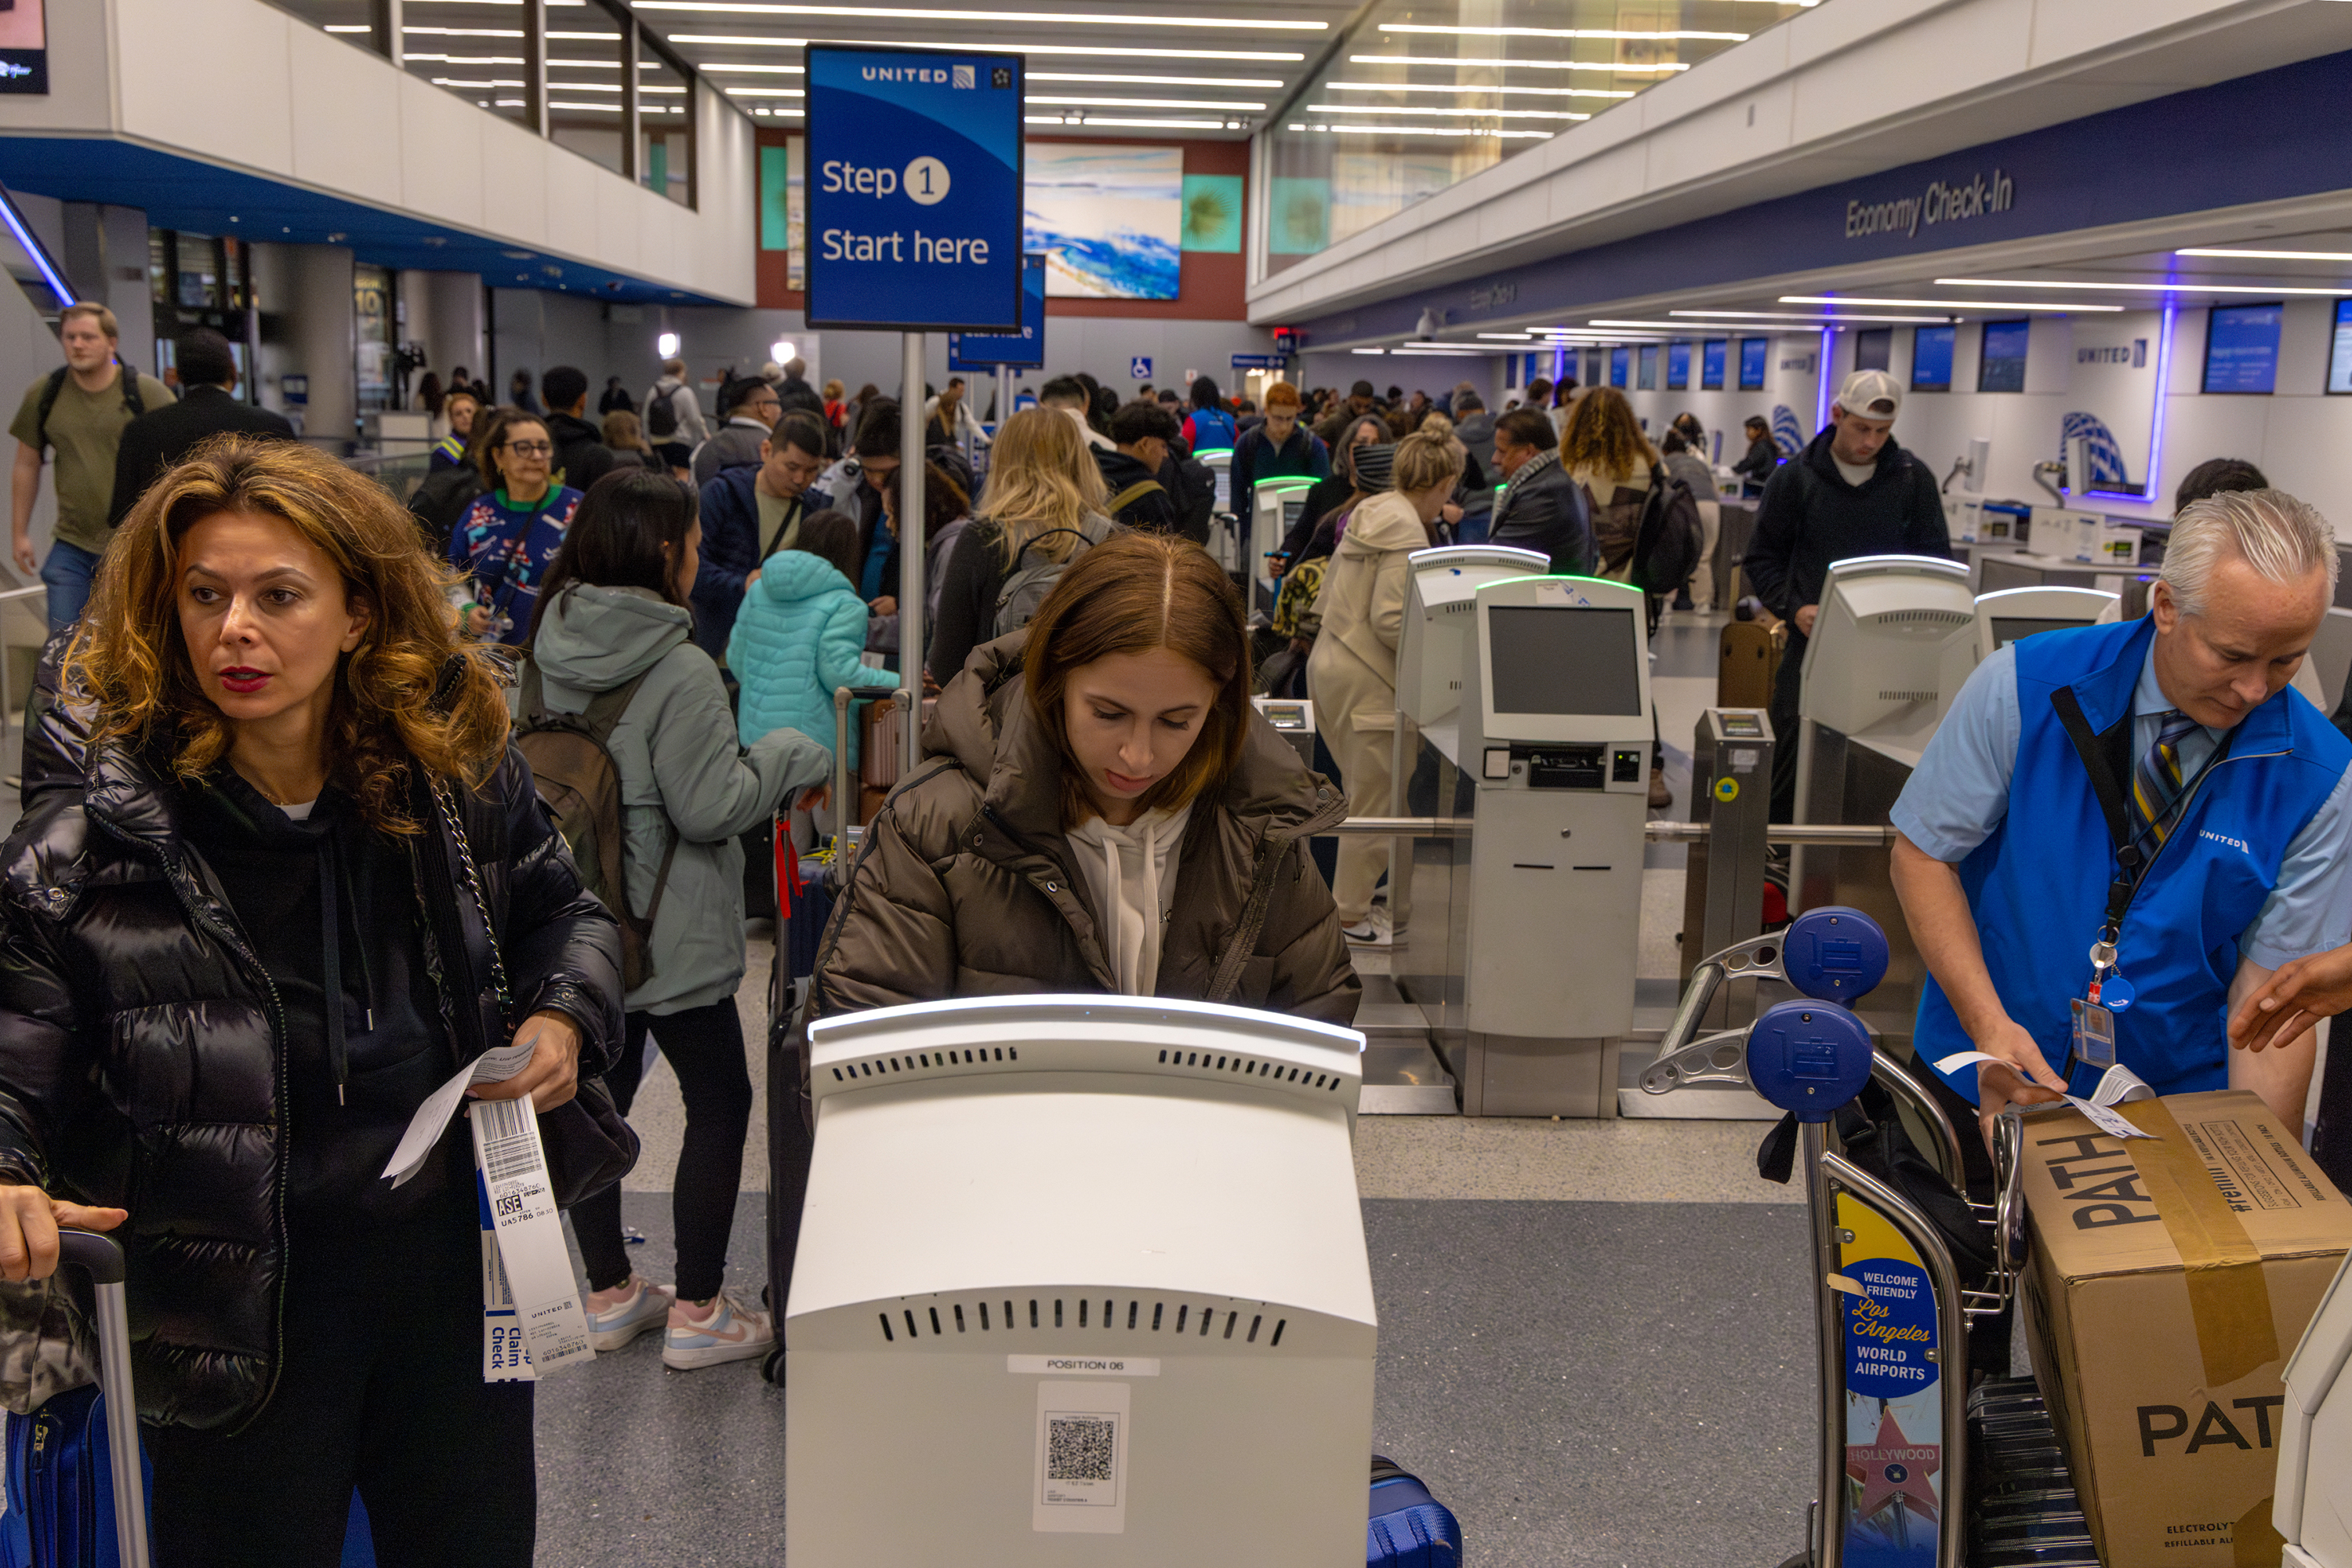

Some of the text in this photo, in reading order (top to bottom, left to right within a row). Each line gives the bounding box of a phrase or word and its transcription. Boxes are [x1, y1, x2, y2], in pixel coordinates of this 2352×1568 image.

[862, 67, 947, 83] UNITED
[822, 160, 935, 198] Step 1
[1846, 169, 2013, 238] Economy Check-In
[822, 228, 989, 264] Start here
[2078, 347, 2131, 364] UNITED
[2199, 829, 2241, 848] UNITED
[2268, 1142, 2291, 1157] BOTTLES
[2281, 1157, 2309, 1179] ALUMINUM
[2031, 1131, 2161, 1230] PATH
[2300, 1179, 2327, 1200] REFILLABLE
[496, 1194, 523, 1217] ASE
[501, 1213, 534, 1226] UA5786
[1864, 1272, 1918, 1287] WELCOME
[1867, 1285, 1917, 1299] FRIENDLY
[532, 1305, 563, 1318] UNITED
[1852, 1298, 1890, 1321] Los
[1853, 1320, 1931, 1344] Angeles
[492, 1327, 505, 1370] Check
[508, 1327, 522, 1367] Claim
[1857, 1345, 1907, 1362] WORLD
[1047, 1359, 1124, 1370] POSITION 06
[1855, 1362, 1926, 1380] AIRPORTS
[1850, 1448, 1935, 1461] HOLLYWOOD
[2165, 1538, 2216, 1548] REFILLABLE
